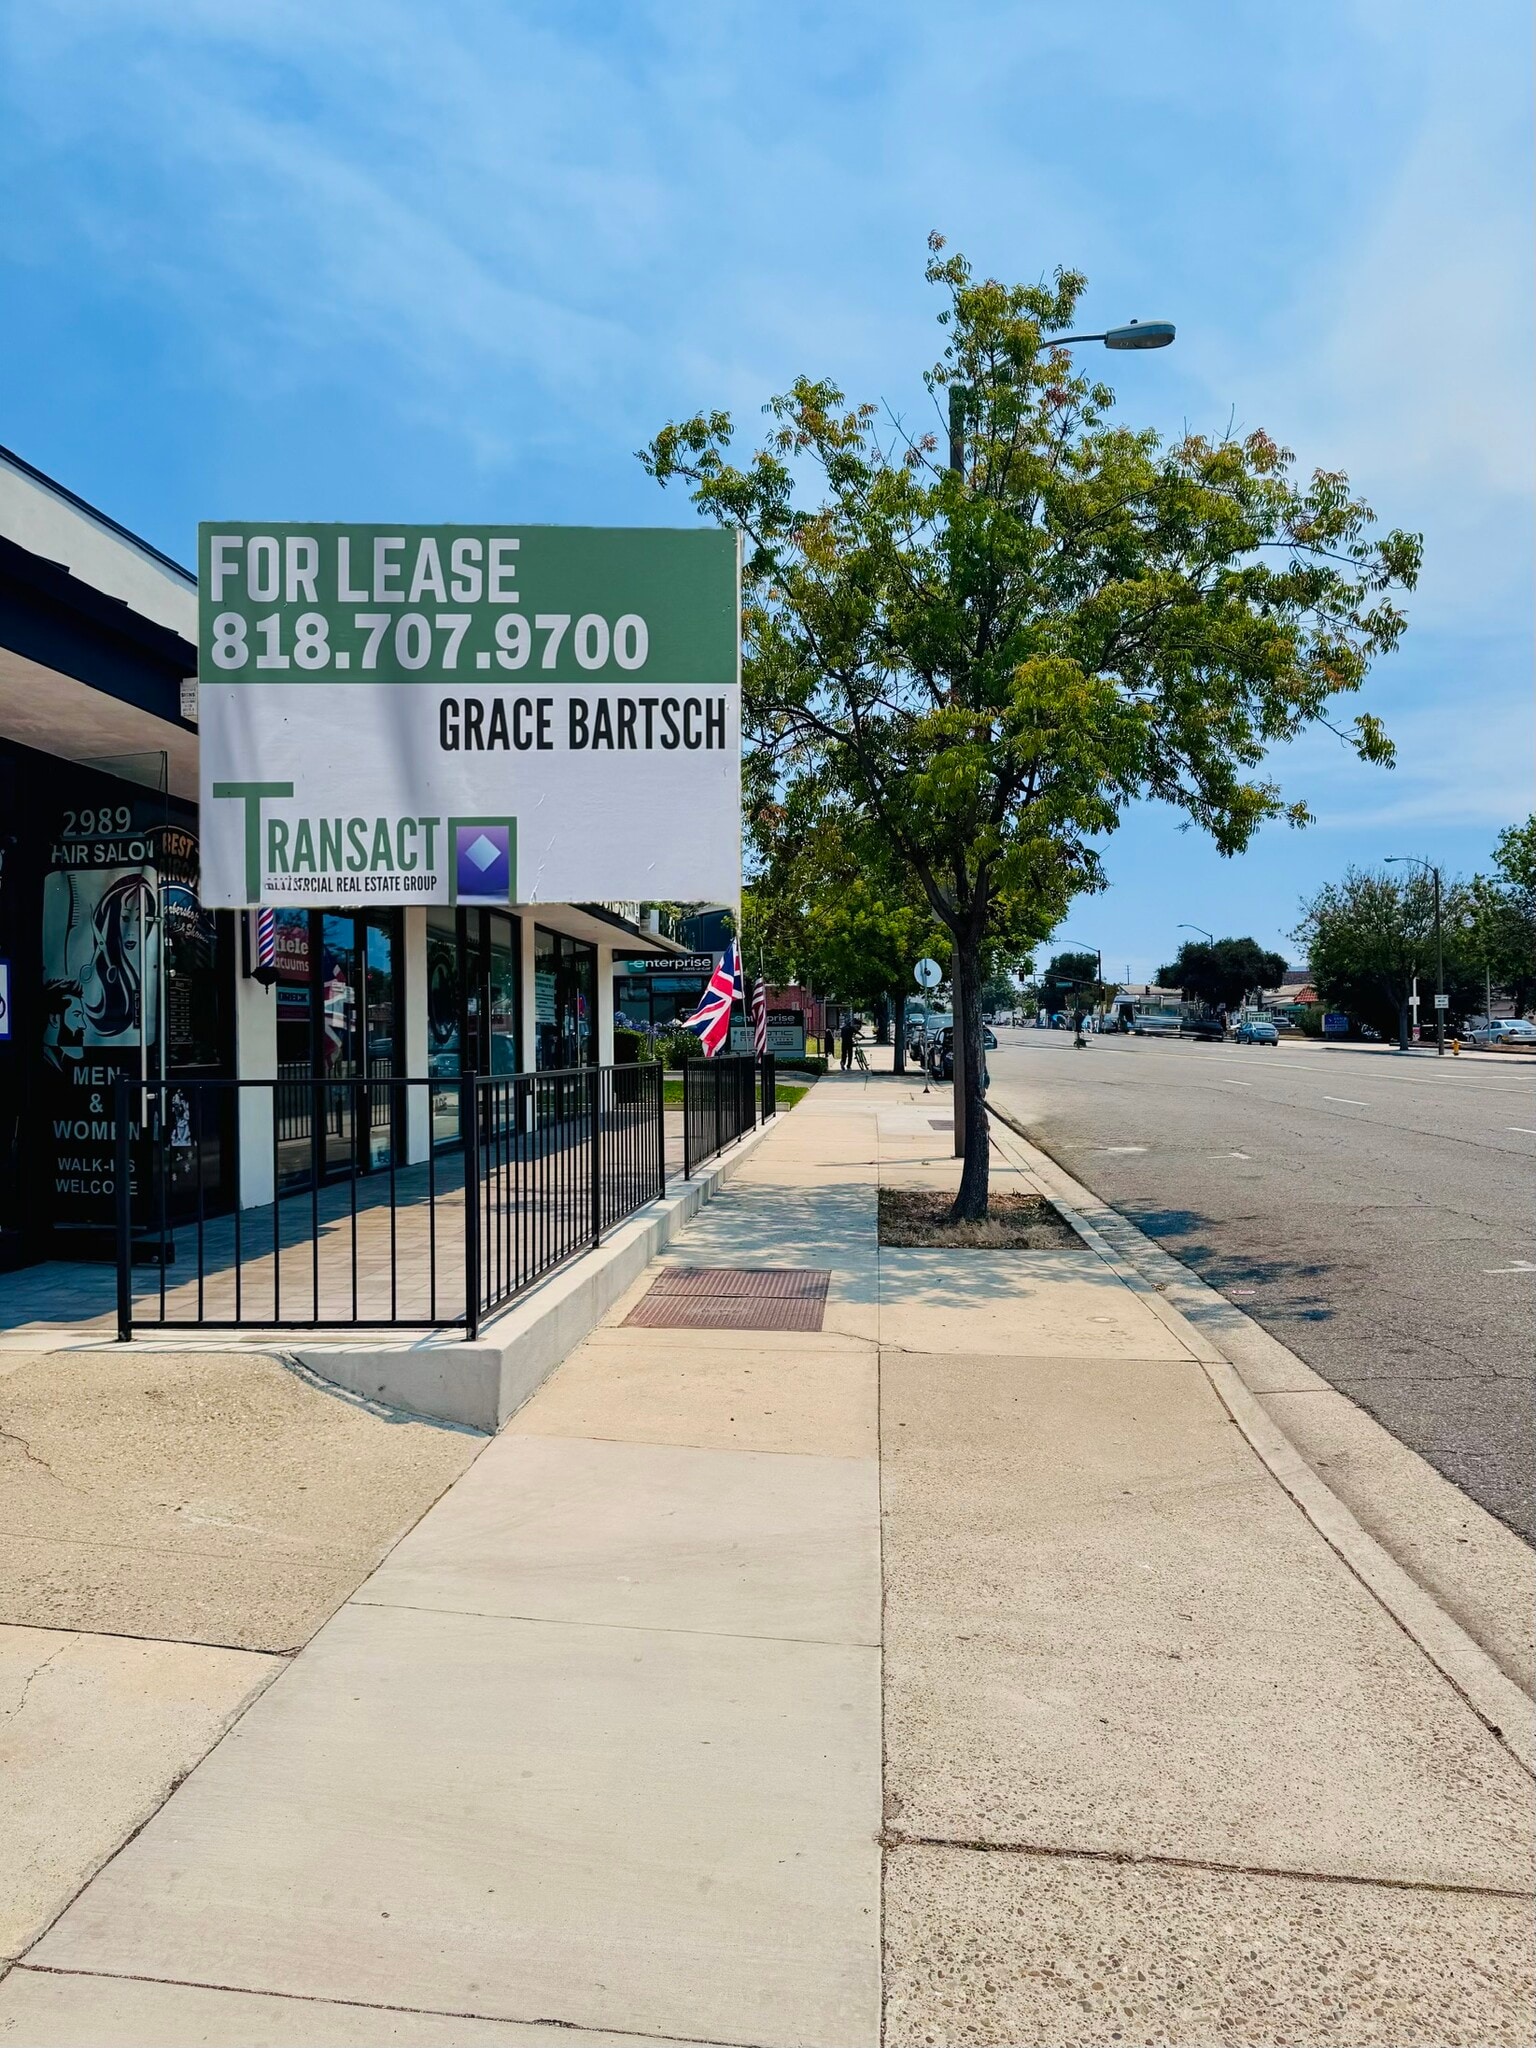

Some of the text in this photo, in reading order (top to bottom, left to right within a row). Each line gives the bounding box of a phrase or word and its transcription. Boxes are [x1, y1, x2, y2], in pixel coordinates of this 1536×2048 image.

[210, 535, 520, 603] FOR LEASE
[211, 613, 649, 671] 818.707.9700
[440, 697, 726, 751] GRACE BARTSCH
[62, 805, 131, 836] 2989
[51, 839, 154, 864] HAIR SALON
[161, 832, 194, 858] BEST
[213, 782, 441, 903] TRANSACT
[336, 876, 362, 892] REAL
[365, 876, 400, 891] ESTATE
[403, 875, 437, 891] GROUP
[275, 934, 309, 955] iele
[274, 957, 310, 972] acuums
[632, 956, 712, 970] enterprise
[73, 1066, 120, 1085] MEN
[89, 1093, 104, 1113] &
[57, 1157, 136, 1173] WALK-IS
[55, 1178, 138, 1195] WELCOE
